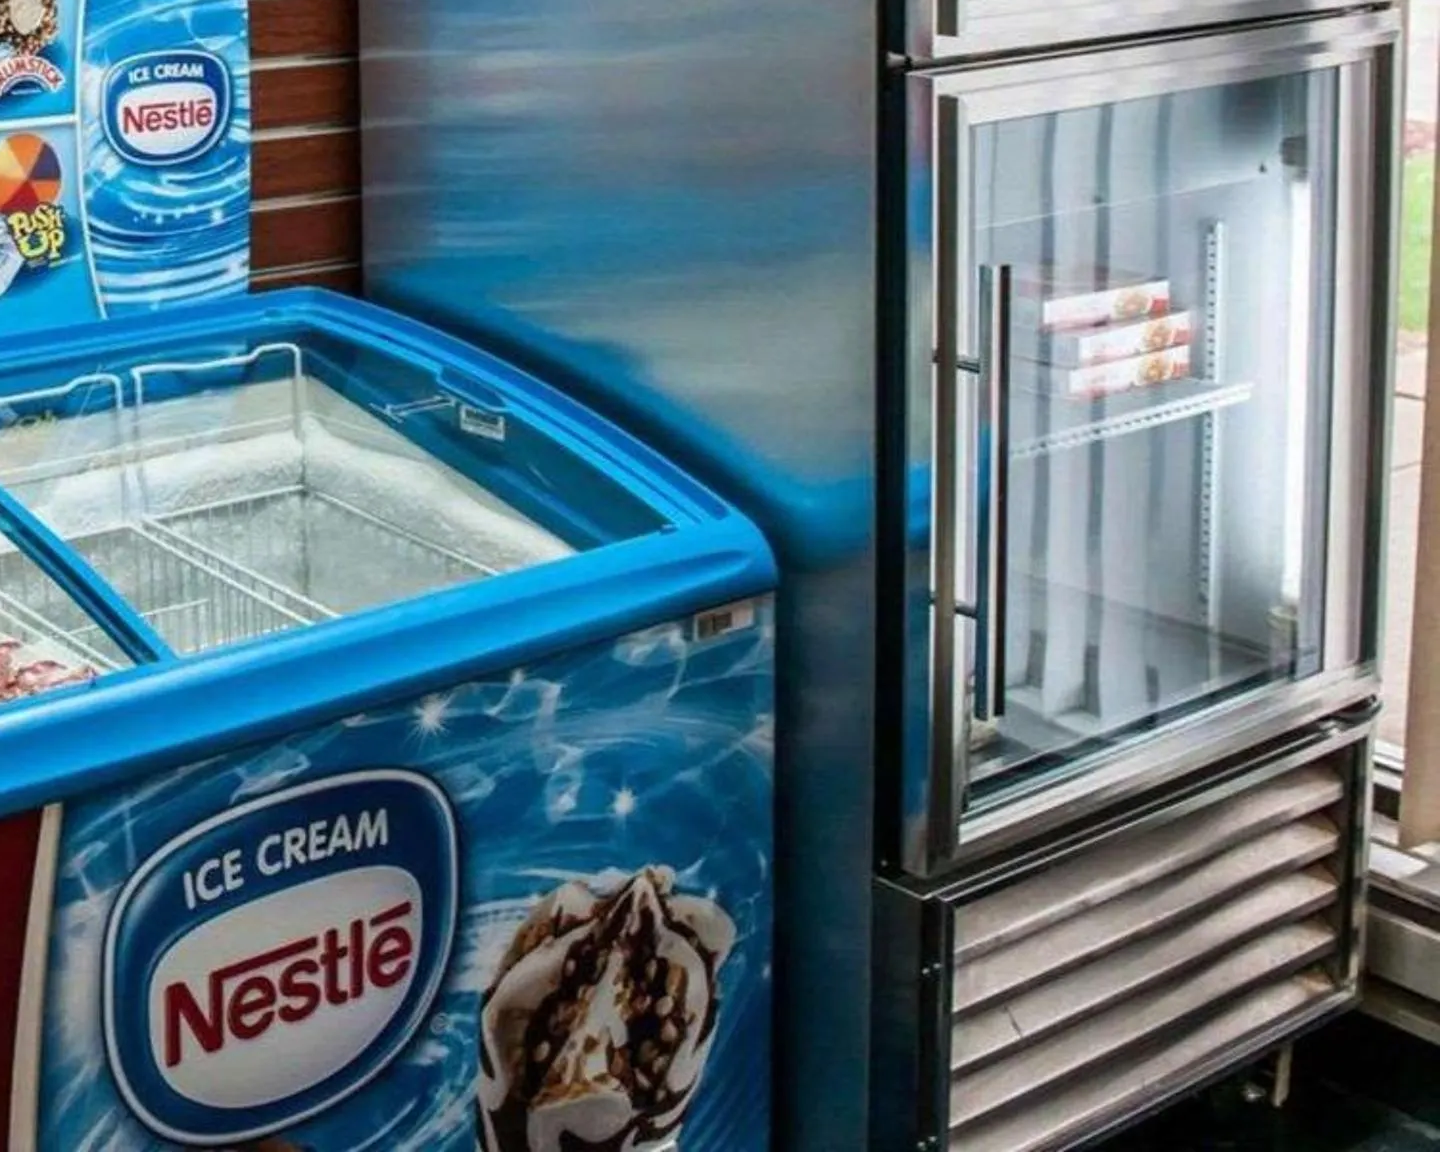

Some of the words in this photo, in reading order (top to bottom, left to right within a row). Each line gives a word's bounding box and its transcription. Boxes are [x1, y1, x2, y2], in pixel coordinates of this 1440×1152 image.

[128, 65, 152, 84] ICE
[154, 62, 205, 80] CREAM
[122, 98, 213, 134] Nestlé
[7, 203, 65, 240] PUSH
[19, 228, 65, 259] UP
[182, 848, 246, 910] ICE
[255, 807, 390, 877] CREAM
[164, 899, 414, 1070] Nestlé
